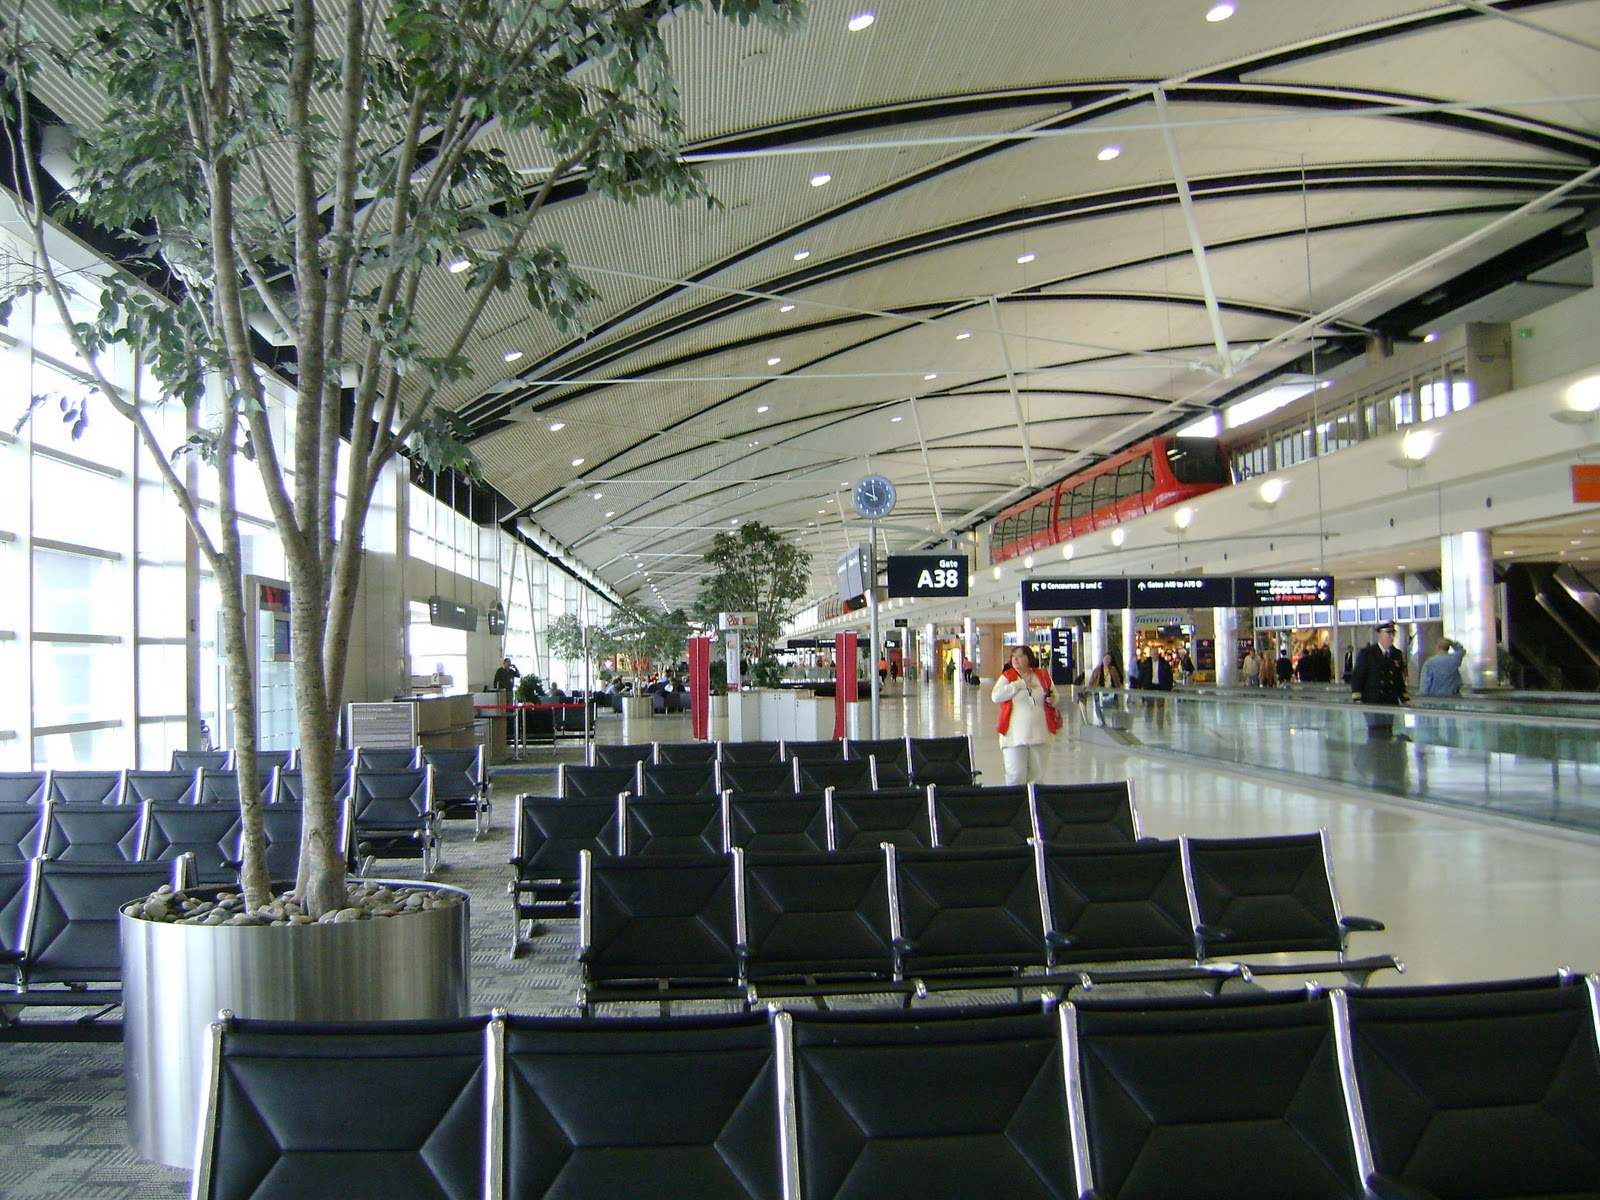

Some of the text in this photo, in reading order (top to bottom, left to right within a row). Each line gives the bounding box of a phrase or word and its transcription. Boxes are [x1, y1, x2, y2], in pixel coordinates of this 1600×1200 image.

[939, 560, 958, 568] Gate
[917, 569, 958, 588] A38
[1047, 582, 1080, 590] Concourses
